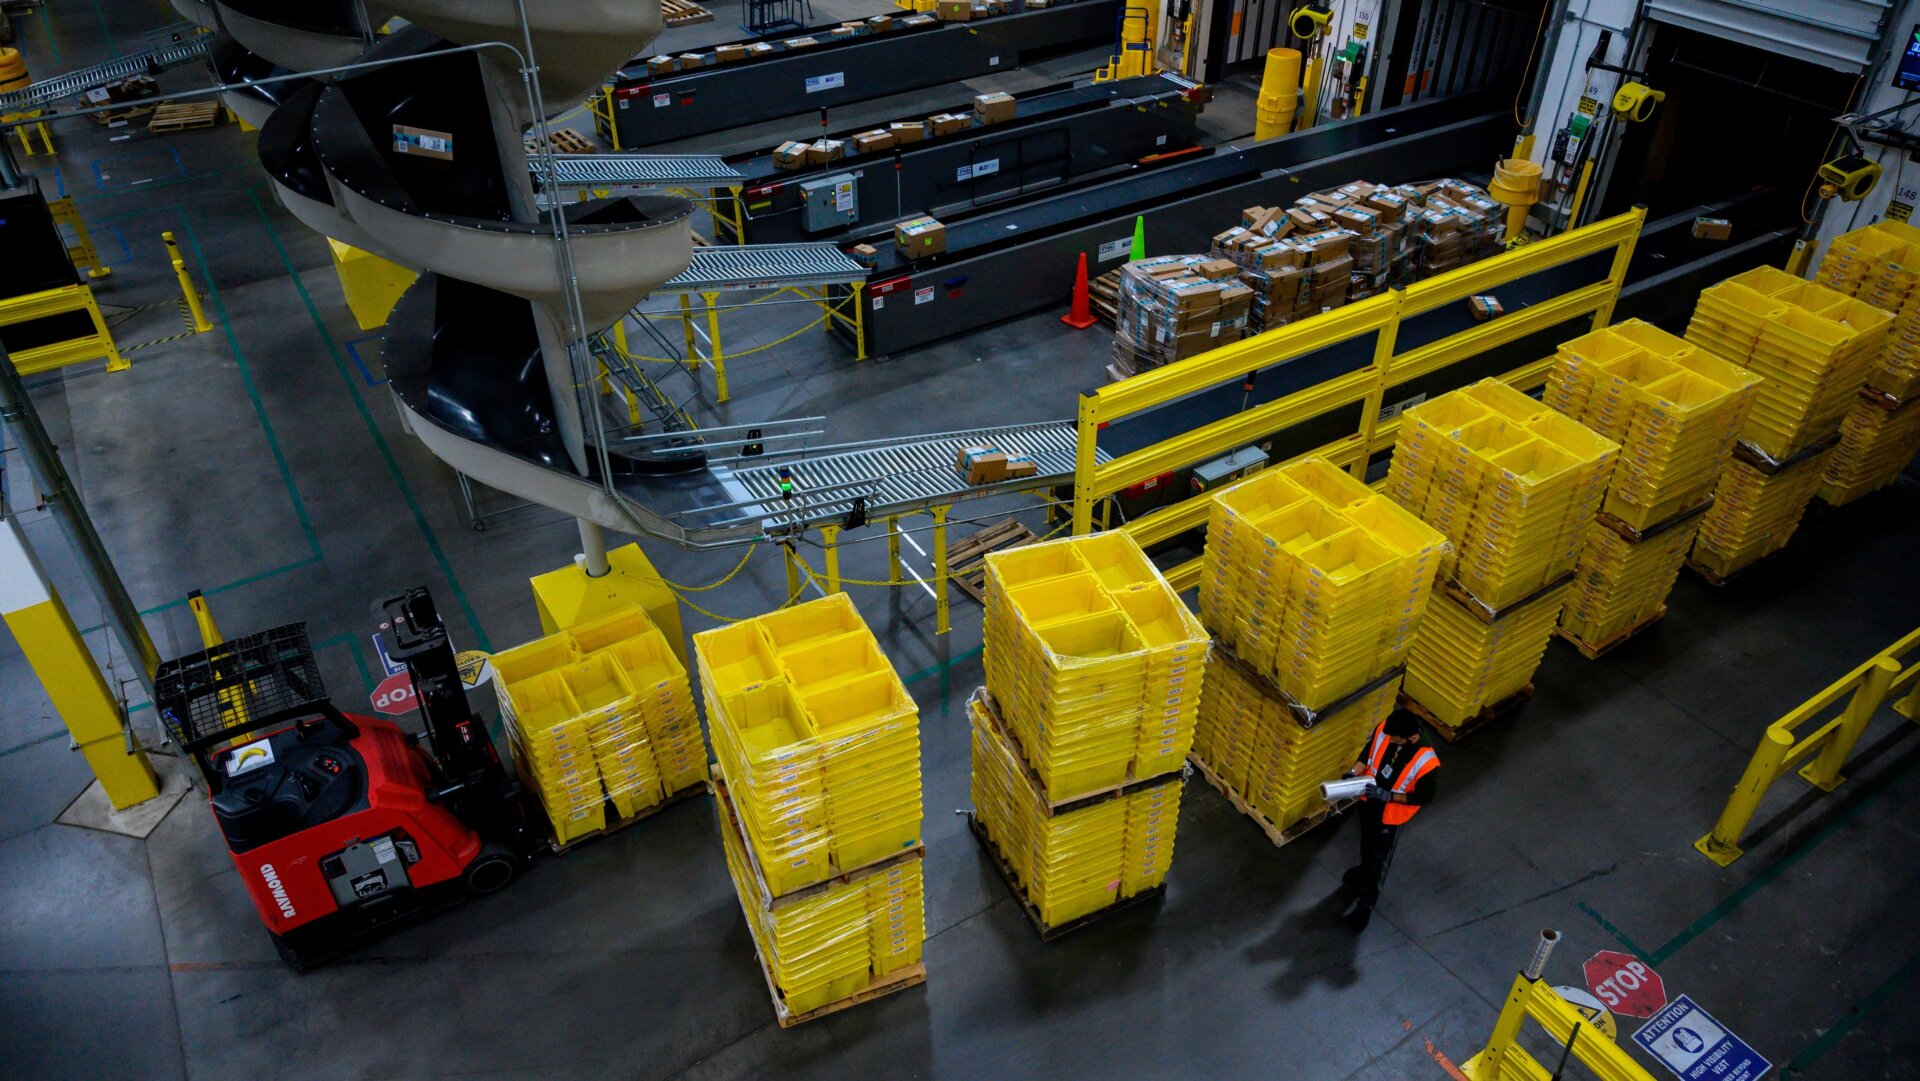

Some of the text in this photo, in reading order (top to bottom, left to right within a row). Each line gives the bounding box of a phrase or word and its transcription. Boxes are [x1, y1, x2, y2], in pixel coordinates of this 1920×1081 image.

[1358, 11, 1369, 21] 150
[1588, 86, 1598, 95] 49
[1897, 187, 1917, 201] 148
[457, 655, 481, 667] CAUTI
[376, 684, 416, 708] TOP
[260, 863, 297, 919] RAYMOND
[1595, 961, 1649, 1006] STOP
[1641, 1002, 1689, 1043] ATTENTION
[1689, 1040, 1734, 1080] HIGH VISIBILITY
[1711, 1059, 1730, 1075] VEST
[1732, 1058, 1752, 1076] BEYOND
